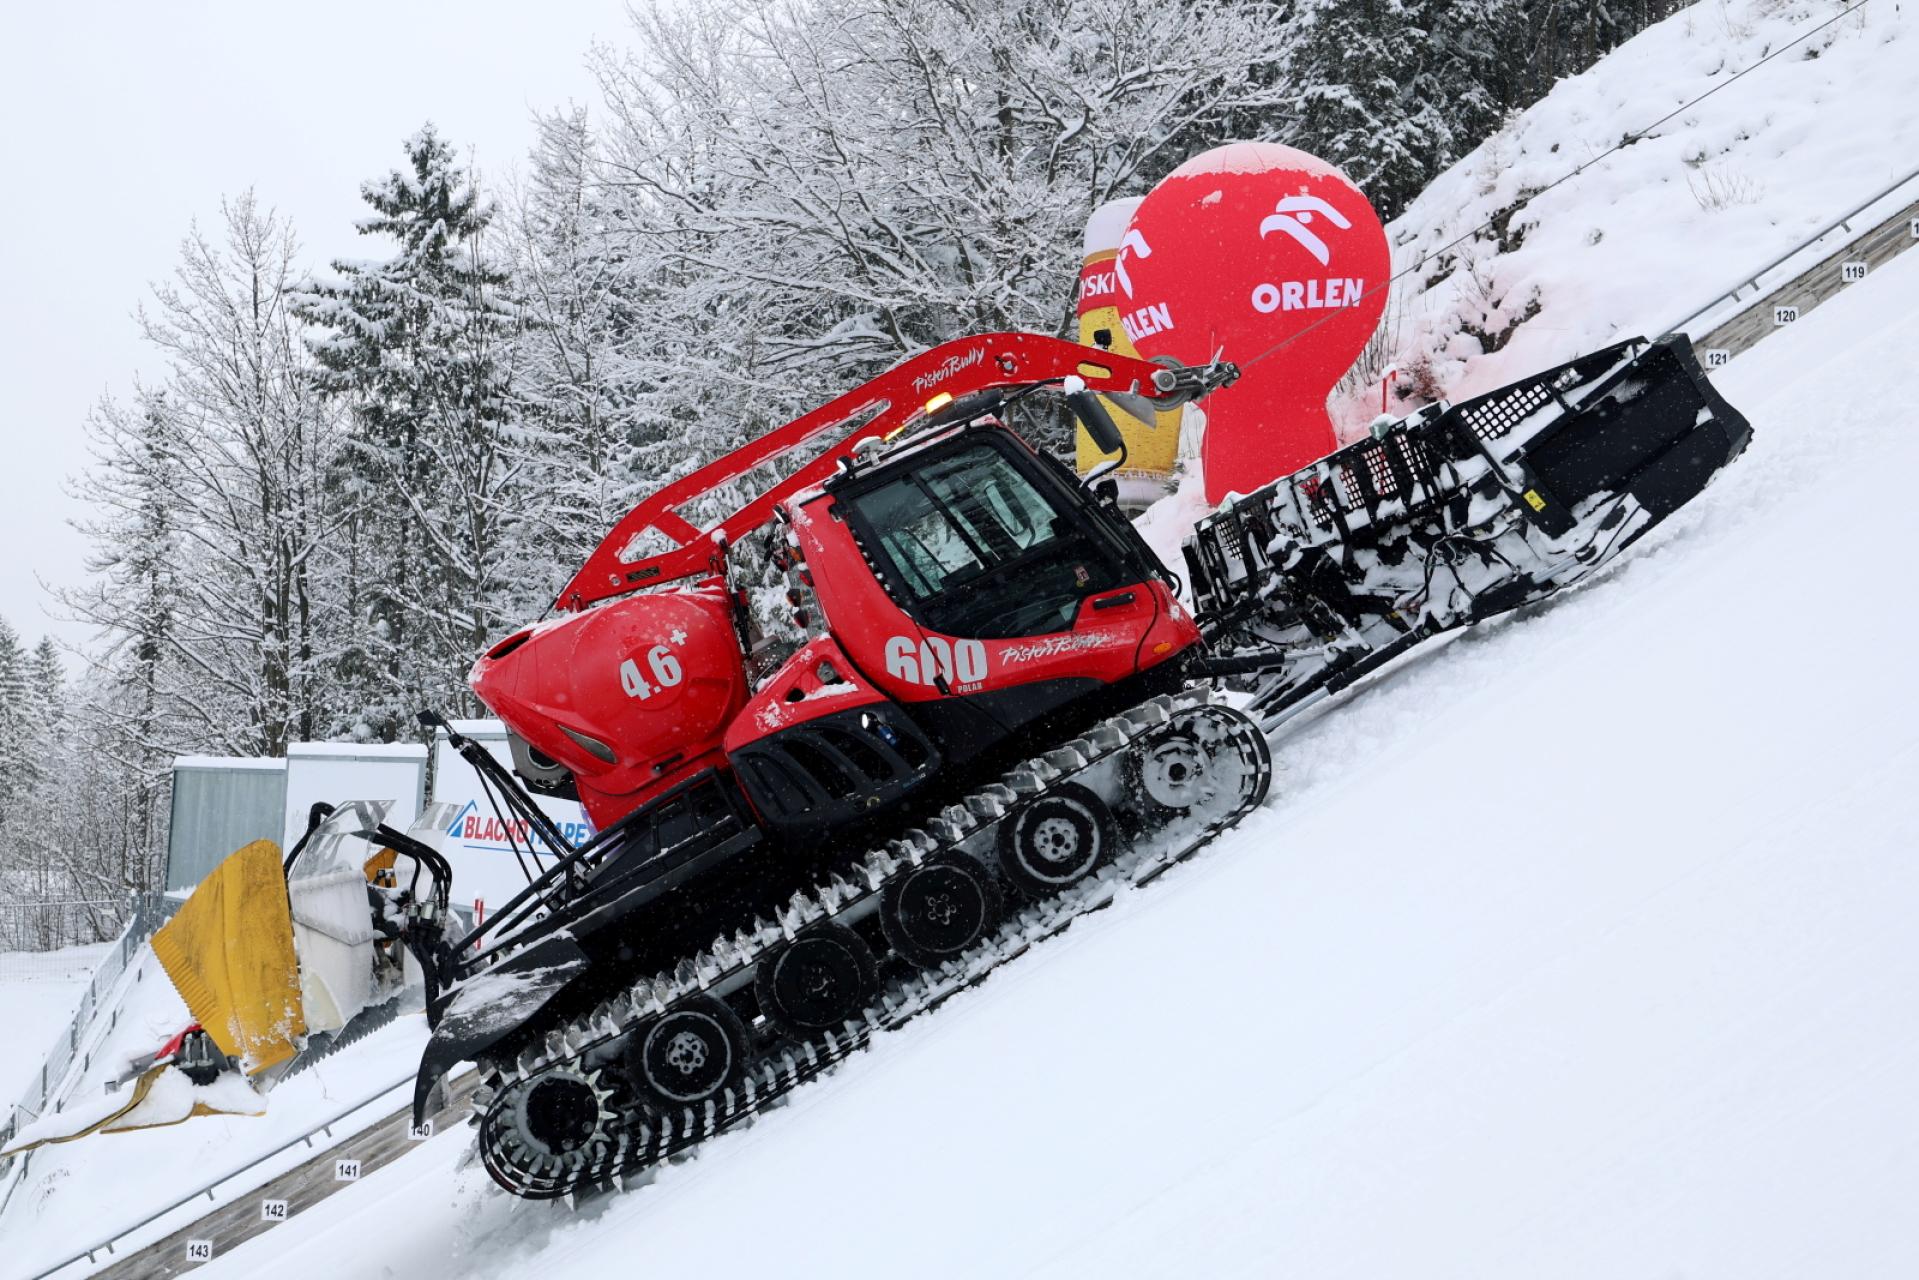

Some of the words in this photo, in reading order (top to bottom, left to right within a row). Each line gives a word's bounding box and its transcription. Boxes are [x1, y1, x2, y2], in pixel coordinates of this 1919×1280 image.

[1845, 266, 1865, 278] 119
[1079, 271, 1115, 300] YSKI
[1251, 278, 1364, 313] ORLEN
[1776, 310, 1796, 322] 120
[1708, 353, 1727, 365] 121
[911, 346, 985, 395] PistenBully
[885, 635, 988, 686] 600
[410, 1123, 431, 1137] 140
[338, 1163, 358, 1177] 141
[264, 1203, 285, 1217] 142
[189, 1244, 209, 1258] 143
